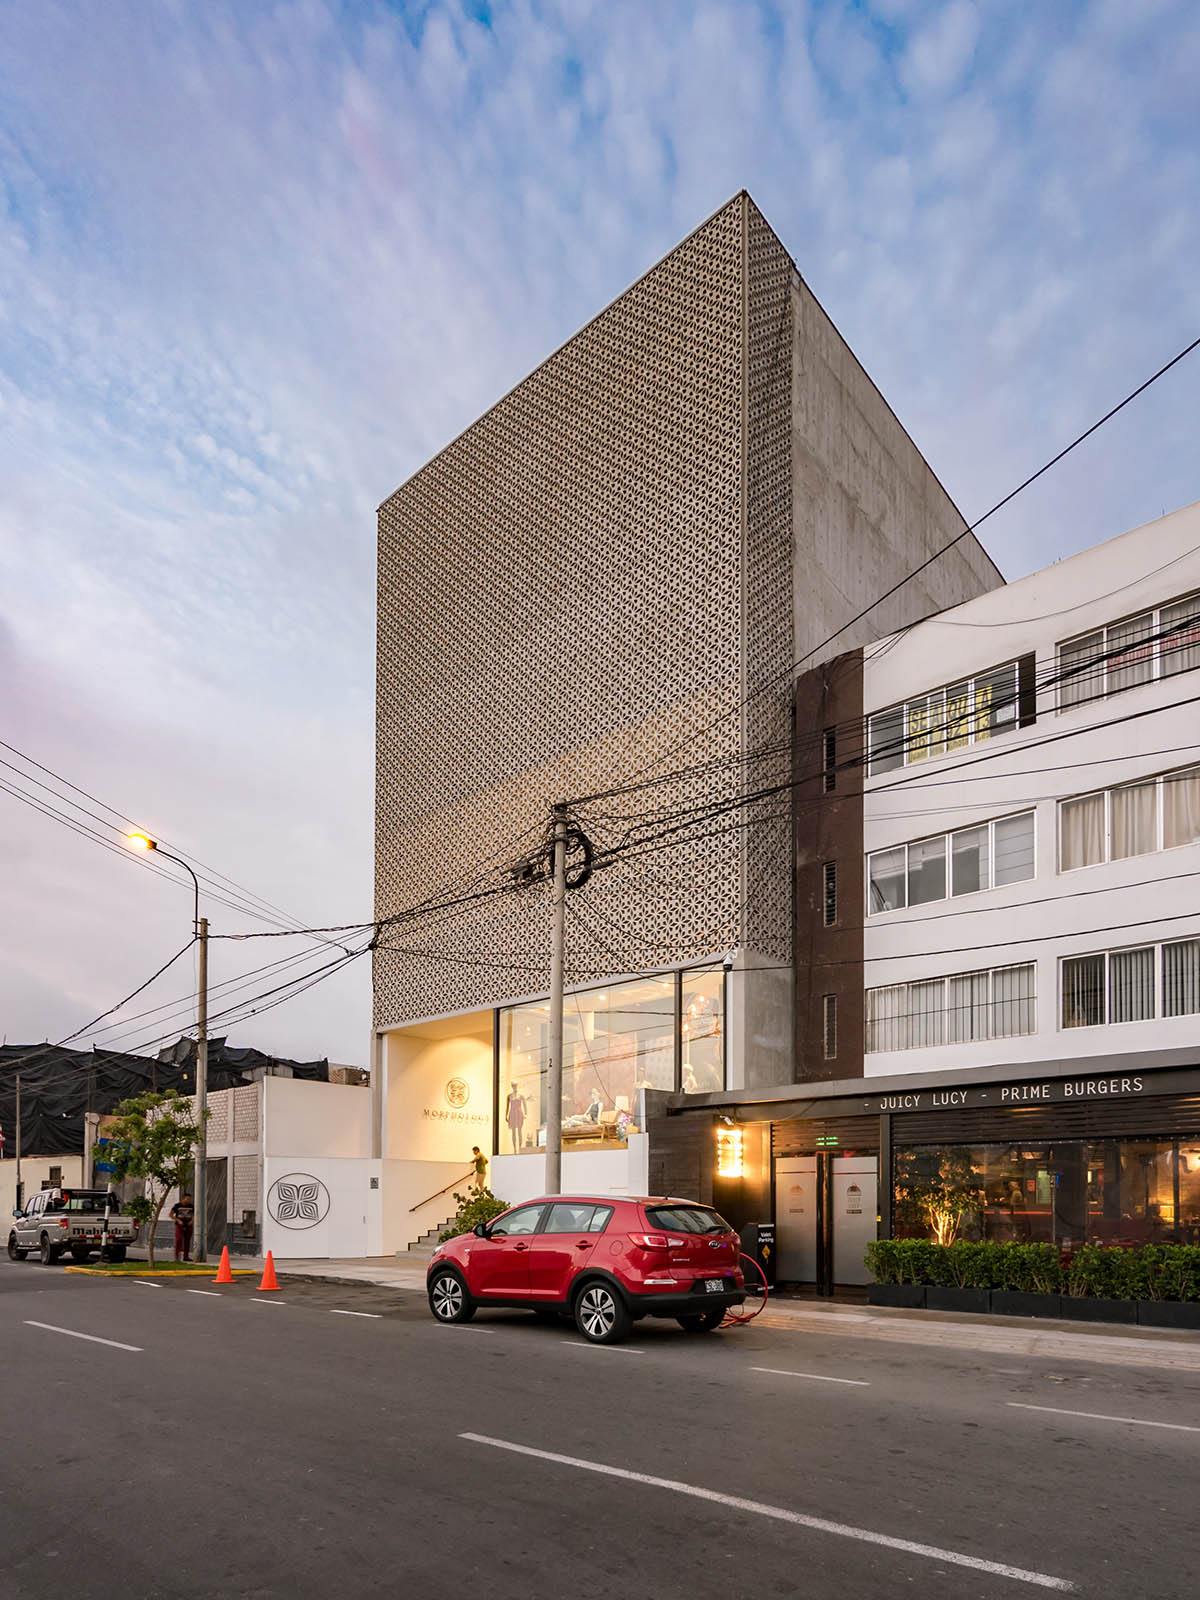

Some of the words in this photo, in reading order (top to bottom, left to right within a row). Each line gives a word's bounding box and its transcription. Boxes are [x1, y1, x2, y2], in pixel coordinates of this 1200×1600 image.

[880, 1095, 921, 1110] JUICY
[932, 1091, 968, 1106] LUCY
[1001, 1084, 1051, 1101] PRIME
[1064, 1077, 1143, 1097] BURGERS
